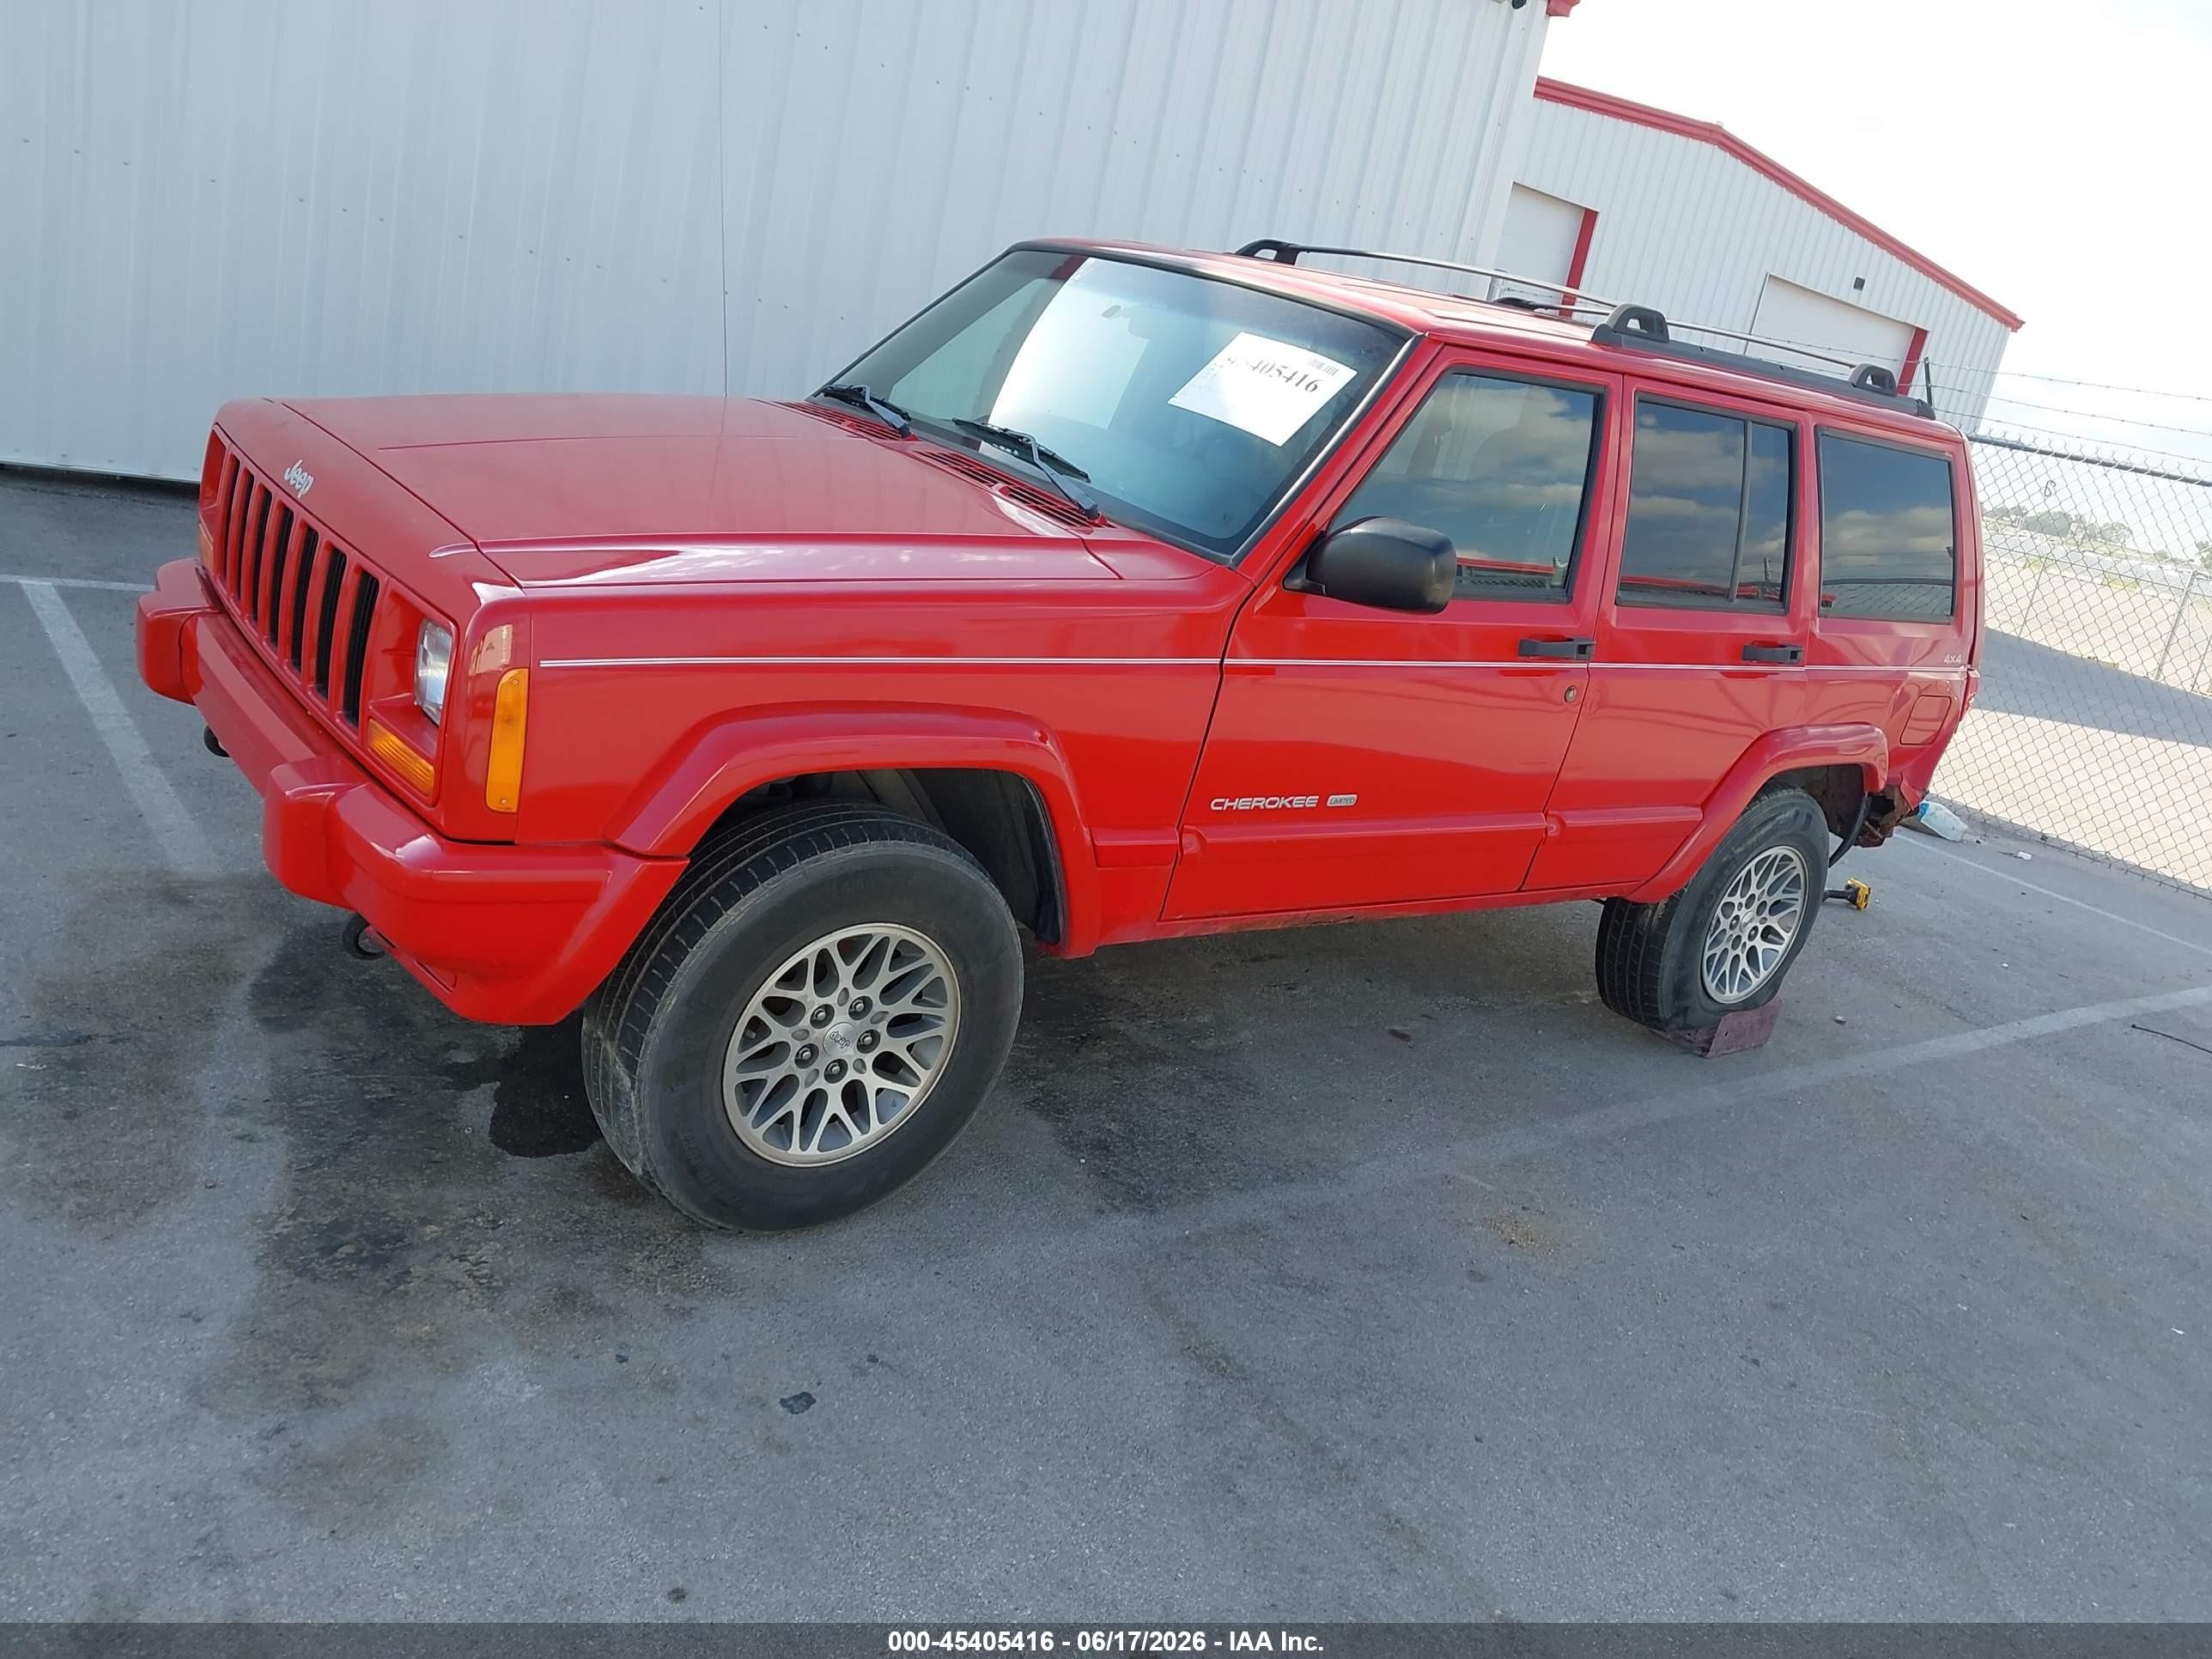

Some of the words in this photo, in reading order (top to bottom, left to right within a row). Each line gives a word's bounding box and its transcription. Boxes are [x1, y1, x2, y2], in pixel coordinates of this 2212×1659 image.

[283, 459, 314, 499] Jeep
[1211, 795, 1320, 811] CHEROKEE
[830, 1030, 851, 1049] Jeep
